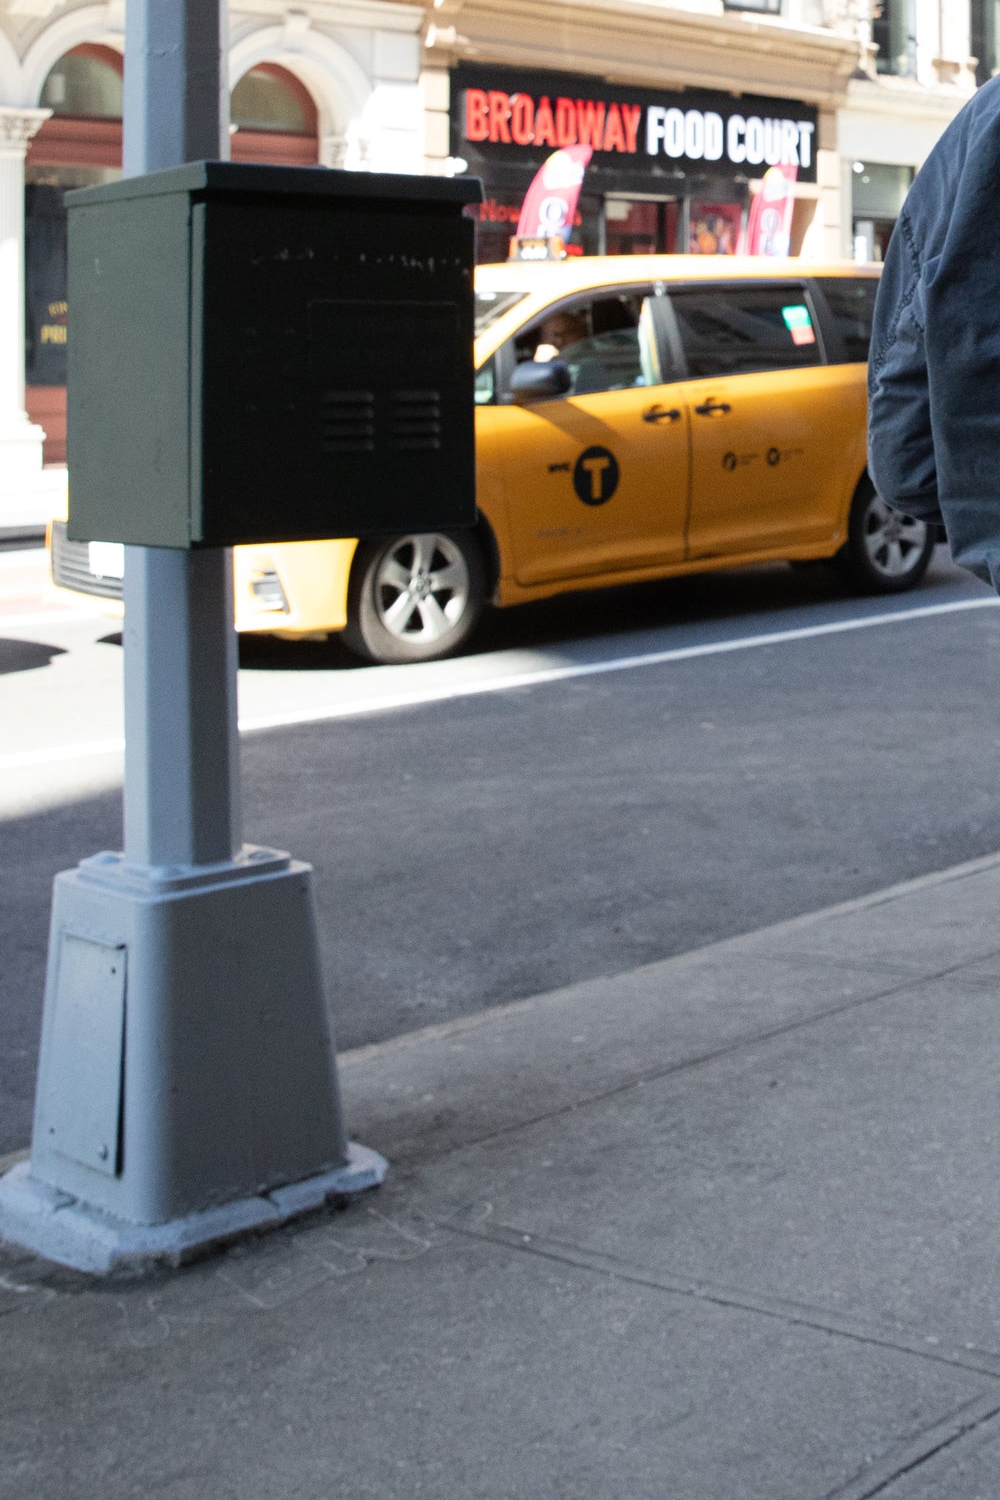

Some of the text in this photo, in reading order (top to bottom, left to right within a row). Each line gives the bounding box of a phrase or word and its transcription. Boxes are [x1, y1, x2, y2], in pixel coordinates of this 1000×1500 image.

[465, 88, 815, 168] BROADWAY FOOD COURT
[581, 456, 611, 501] T
